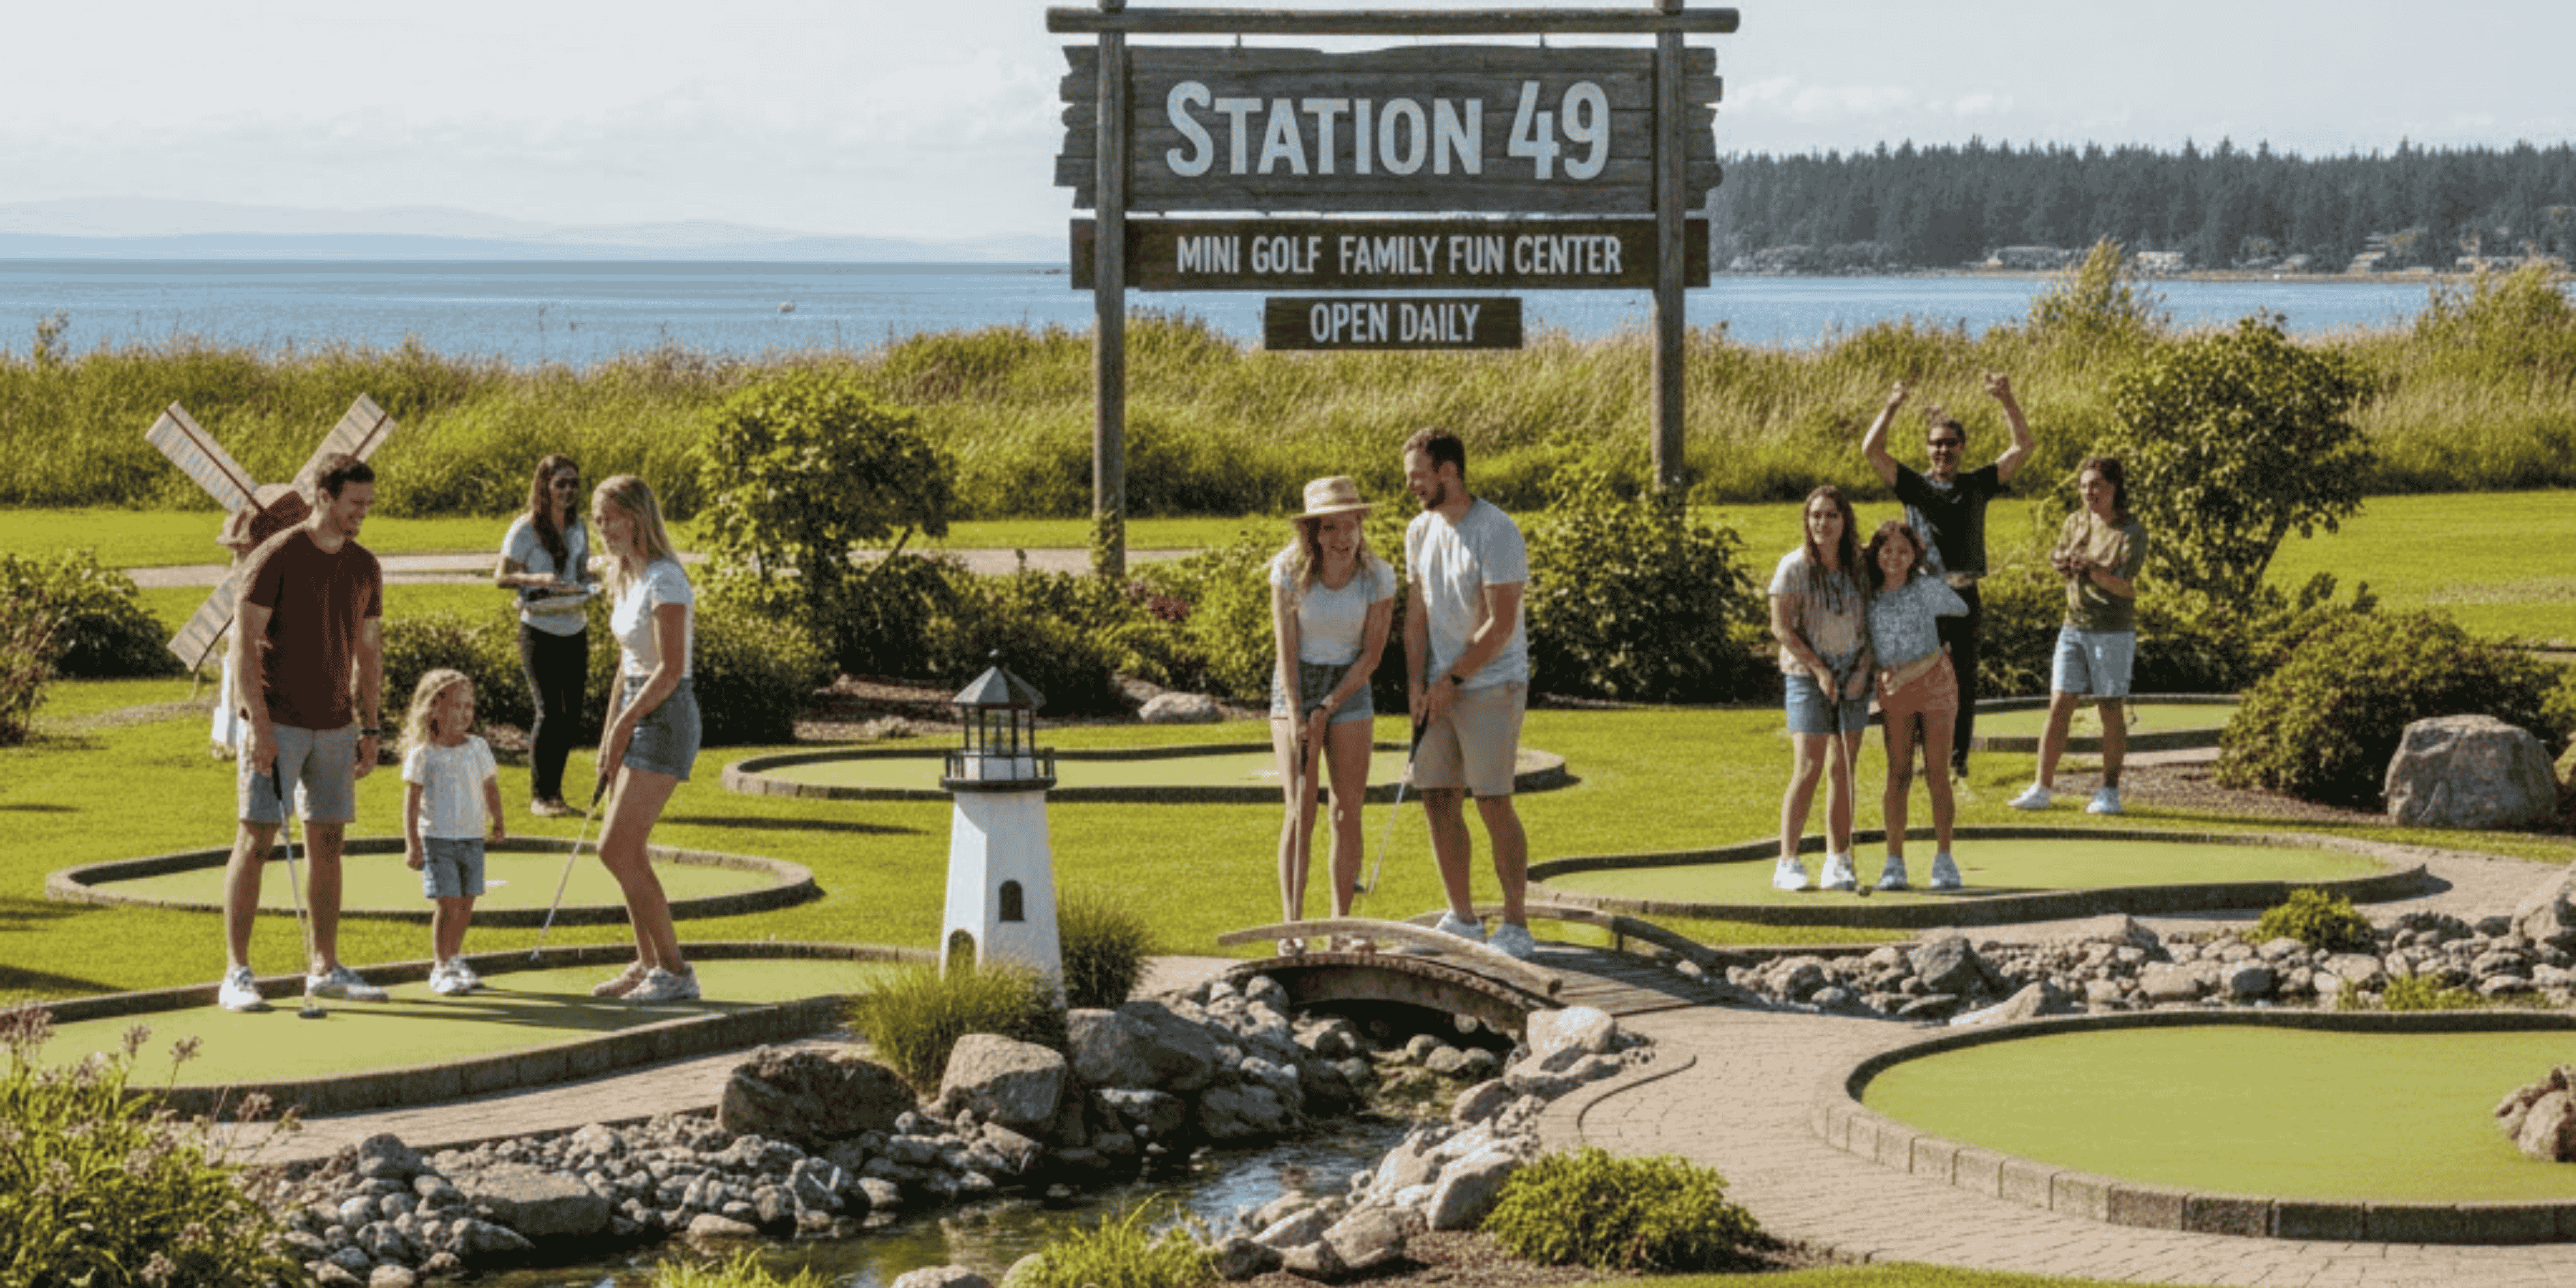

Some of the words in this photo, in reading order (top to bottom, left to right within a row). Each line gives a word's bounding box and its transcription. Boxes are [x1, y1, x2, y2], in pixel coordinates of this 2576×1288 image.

[1167, 81, 1482, 176] STATION
[1508, 80, 1609, 179] 49
[1178, 236, 1239, 273] MINI
[1251, 236, 1321, 273] GOLF
[1340, 236, 1439, 274] FAMILY
[1449, 236, 1505, 274] FUN
[1514, 235, 1622, 273] CENTER
[1310, 303, 1387, 342] OPEN
[1400, 303, 1479, 341] DAILY
